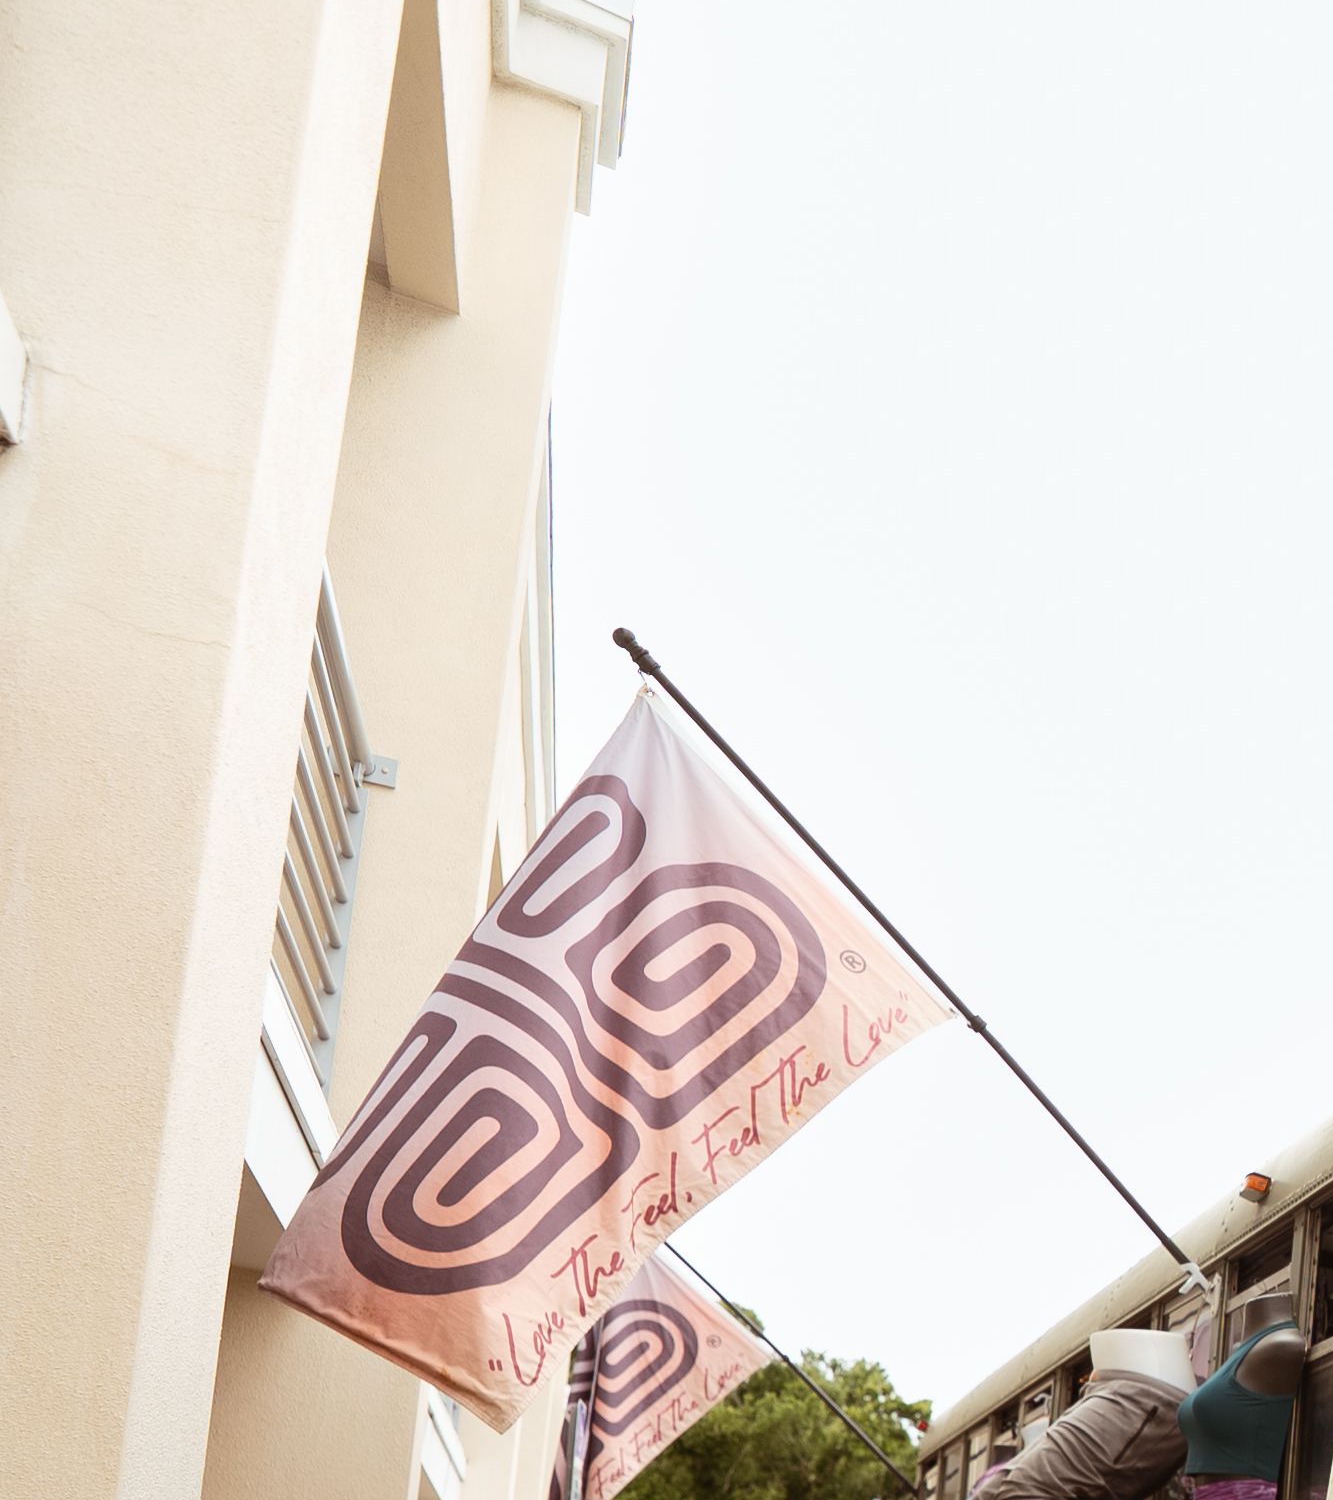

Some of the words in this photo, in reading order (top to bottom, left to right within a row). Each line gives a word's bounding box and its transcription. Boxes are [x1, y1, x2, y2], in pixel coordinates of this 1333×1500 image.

[550, 1233, 625, 1317] The
[691, 1086, 761, 1185] Feel
[753, 1045, 831, 1125] The
